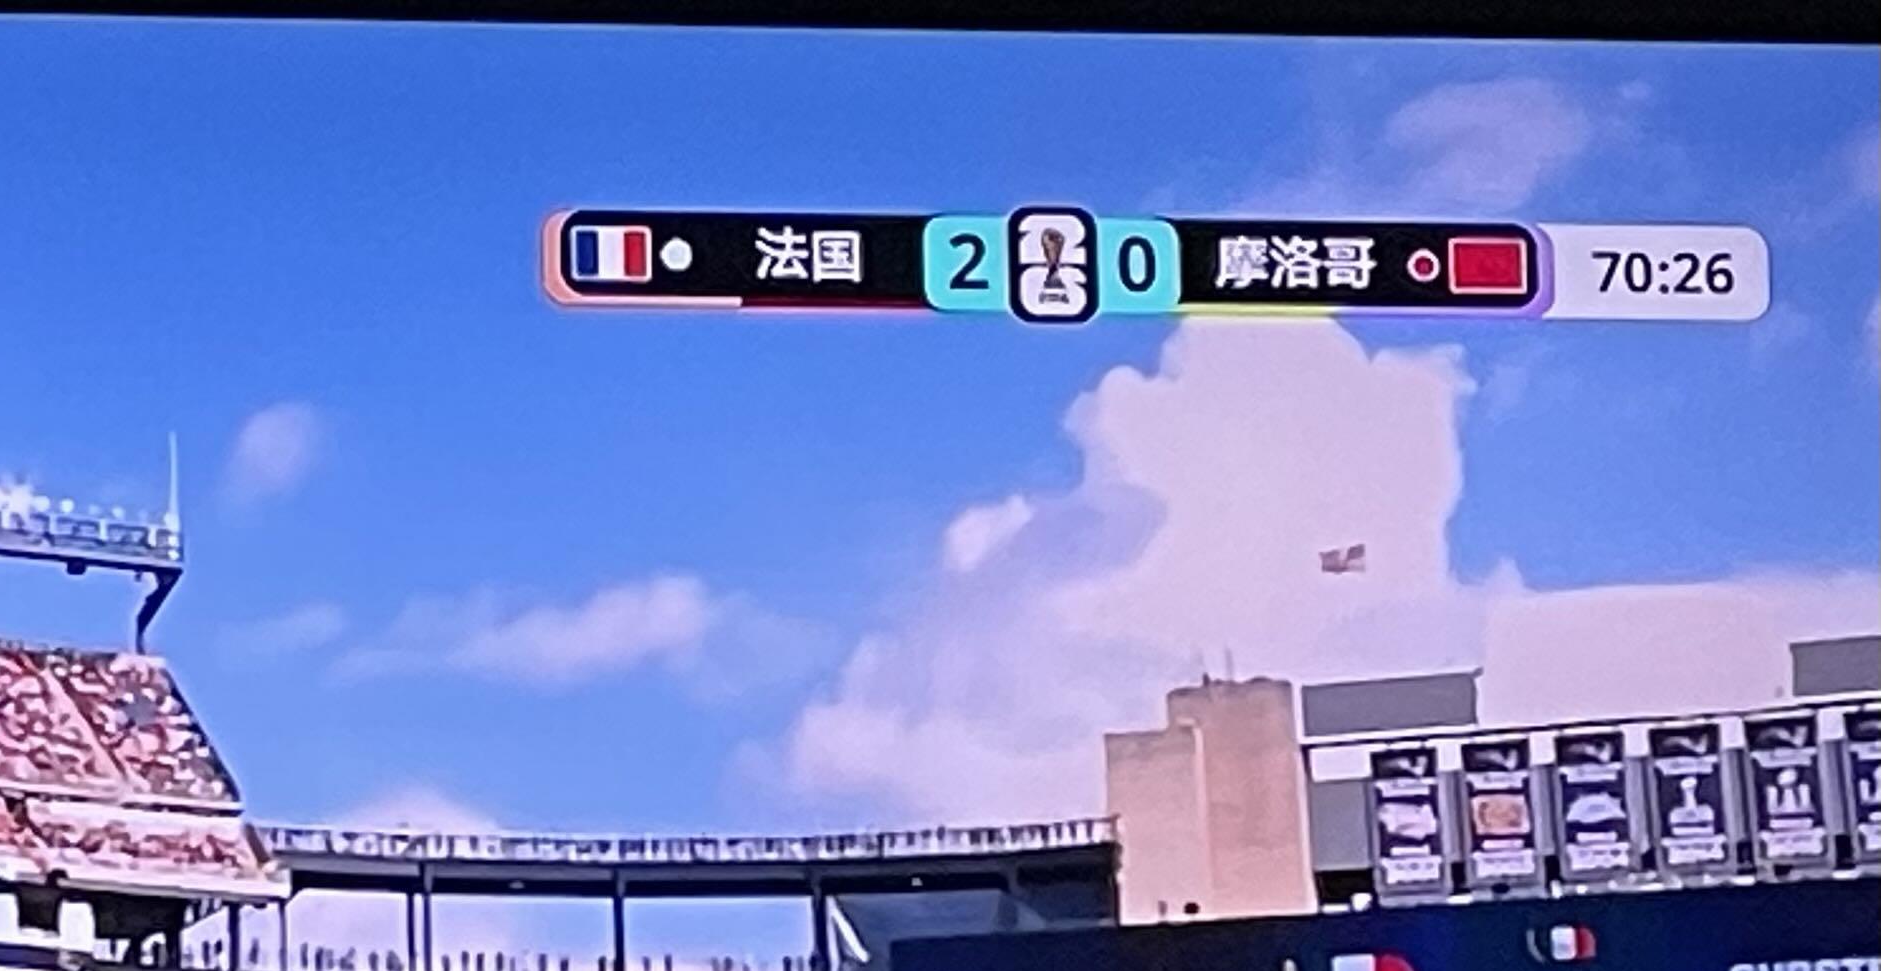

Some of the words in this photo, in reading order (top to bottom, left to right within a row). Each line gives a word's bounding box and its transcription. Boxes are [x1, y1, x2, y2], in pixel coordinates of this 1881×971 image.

[755, 226, 862, 283] 法国
[949, 233, 989, 290] 2
[1118, 236, 1156, 292] 0
[1216, 236, 1376, 289] 摩洛哥
[1591, 250, 1735, 294] 70:26
